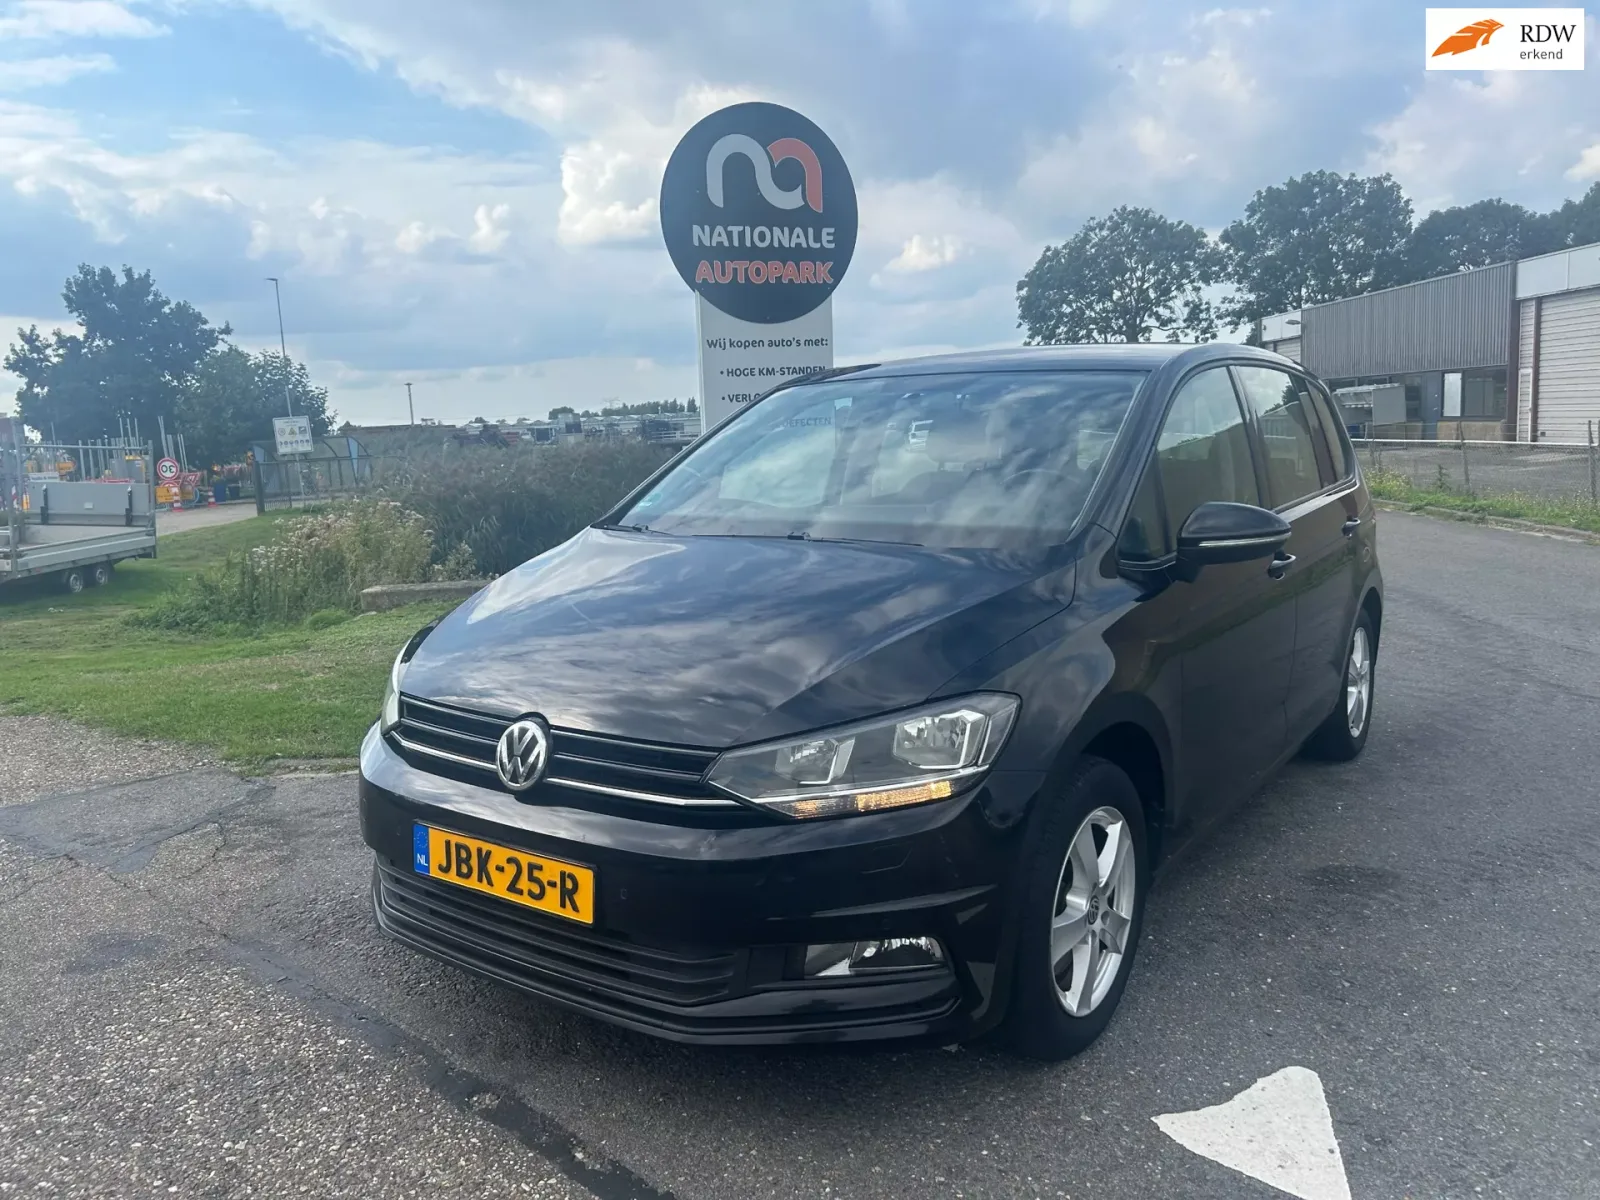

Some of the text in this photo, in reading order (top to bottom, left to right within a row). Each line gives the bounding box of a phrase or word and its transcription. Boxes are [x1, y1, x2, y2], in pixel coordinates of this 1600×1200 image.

[692, 224, 836, 249] NATIONALE
[695, 260, 834, 284] AUTOPARK
[706, 337, 829, 350] Wij kopen auto's met:
[726, 367, 756, 377] HOGE
[416, 853, 429, 867] NL
[437, 839, 580, 913] JBK-25-R
